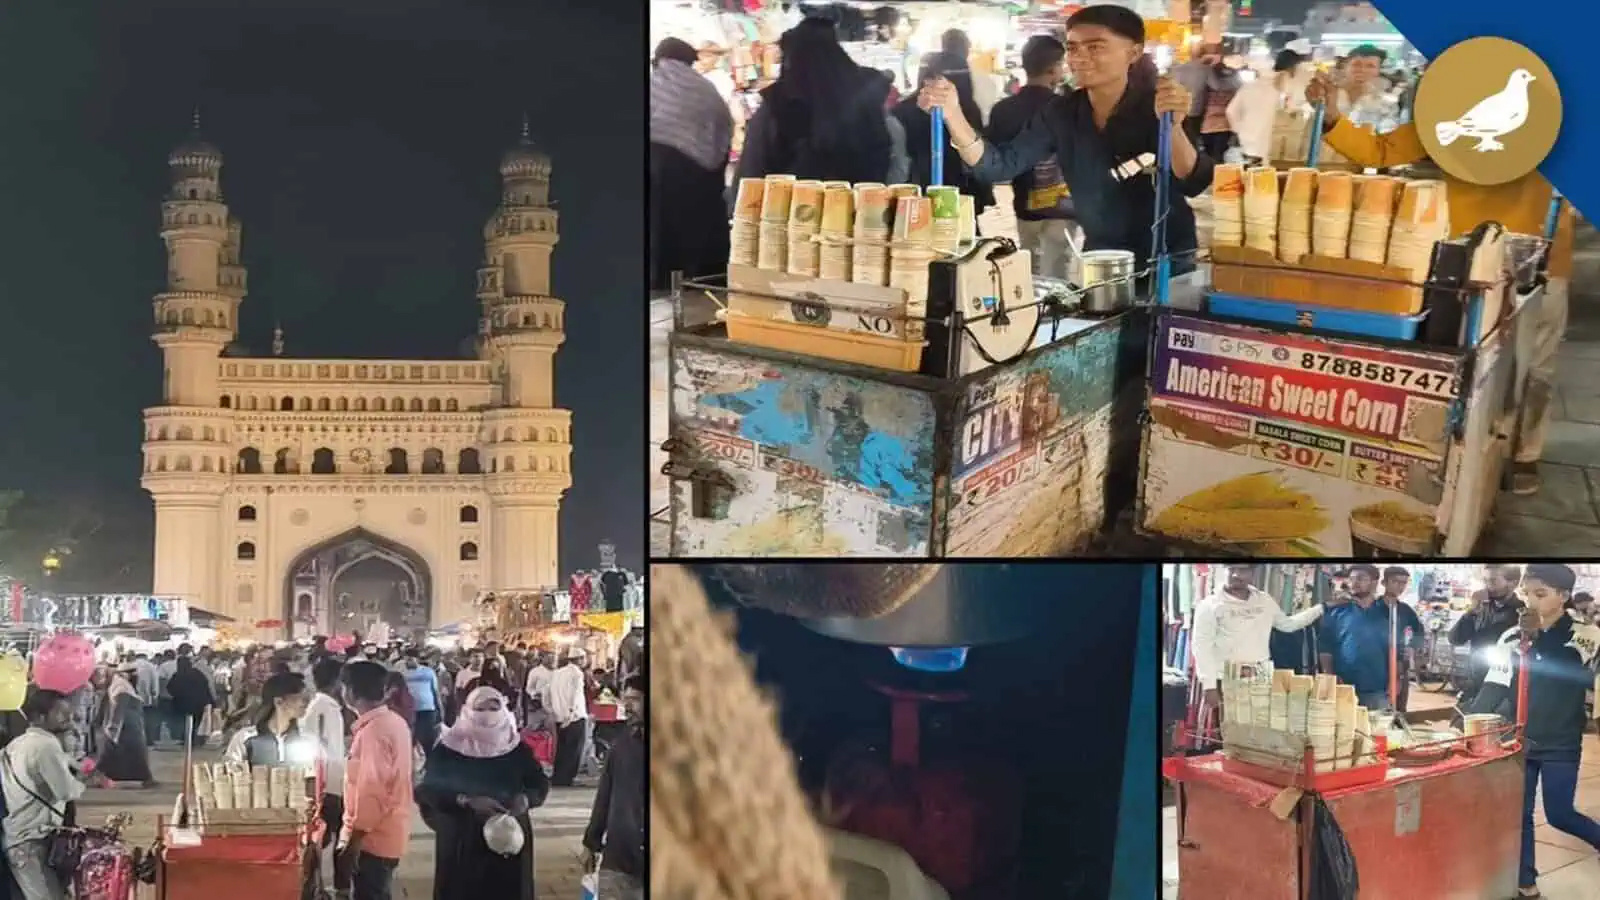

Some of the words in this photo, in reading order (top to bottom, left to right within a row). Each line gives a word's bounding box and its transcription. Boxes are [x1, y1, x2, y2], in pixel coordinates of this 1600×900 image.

[857, 314, 892, 334] NO
[1165, 356, 1265, 408] American
[1269, 374, 1338, 422] Sweet
[1340, 387, 1399, 435] Corn
